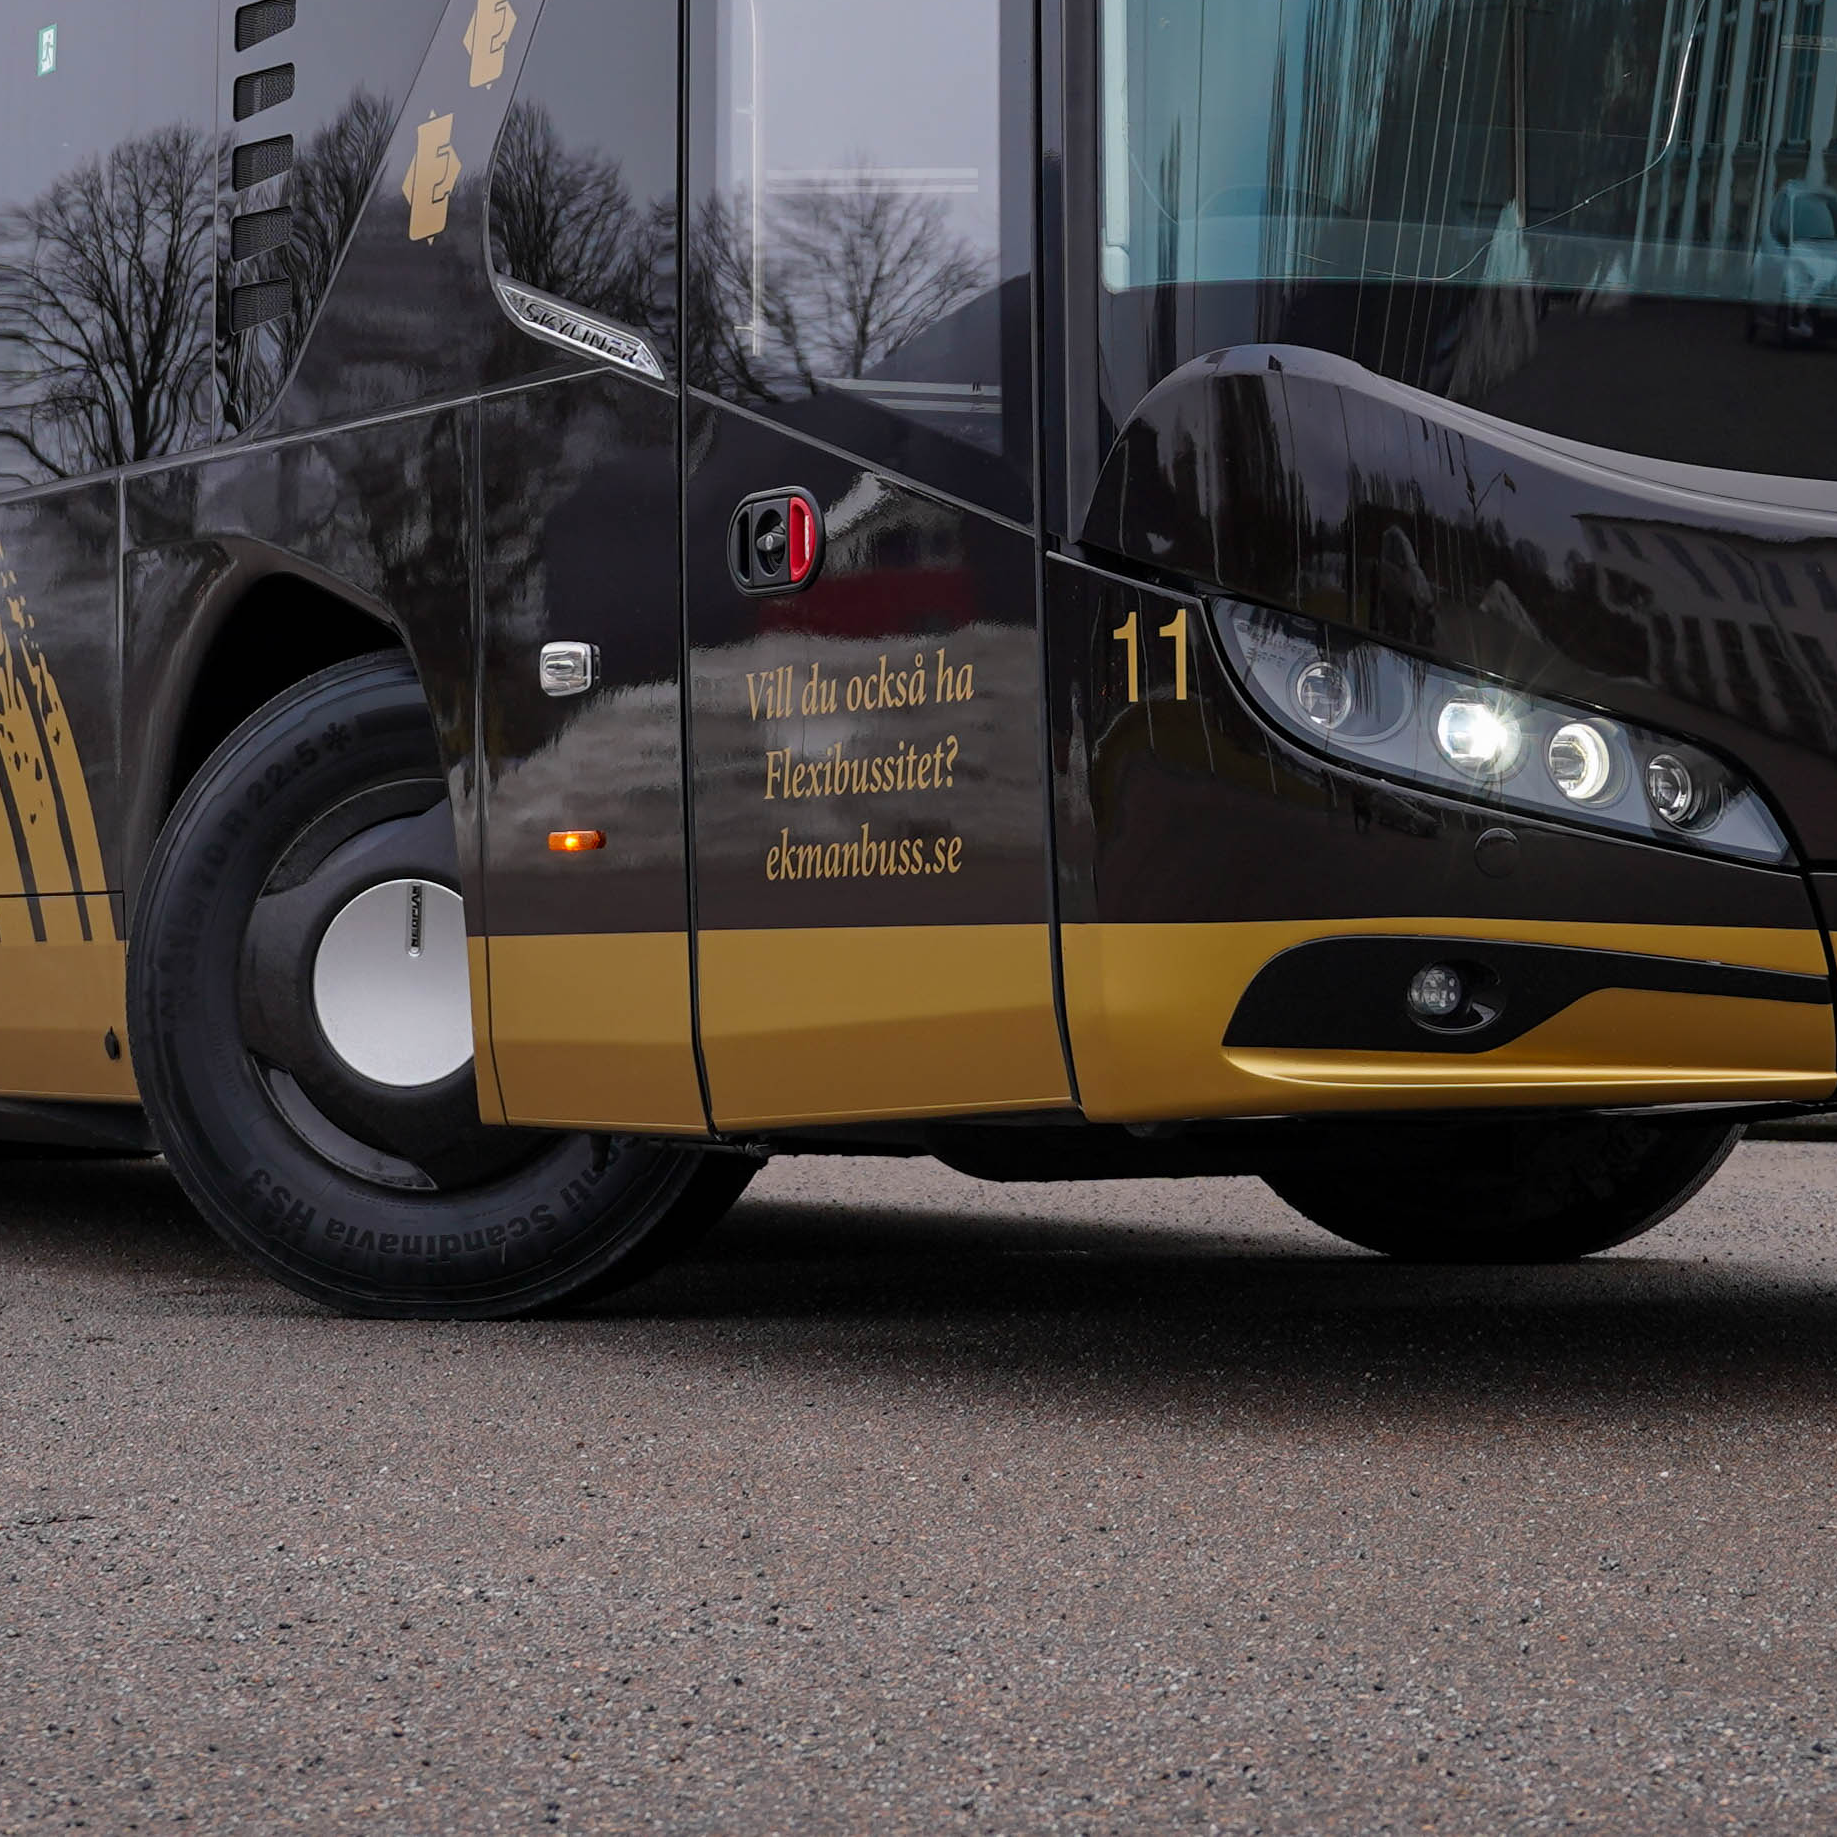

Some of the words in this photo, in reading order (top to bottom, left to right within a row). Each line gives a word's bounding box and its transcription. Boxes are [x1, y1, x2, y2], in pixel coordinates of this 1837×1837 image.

[746, 662, 794, 721] Vill
[801, 658, 838, 712] du
[846, 653, 928, 710] också
[935, 648, 975, 705] ha
[1113, 607, 1188, 703] 11
[764, 735, 960, 801] Flexibussitet?
[765, 823, 963, 881] ekmanbuss.se
